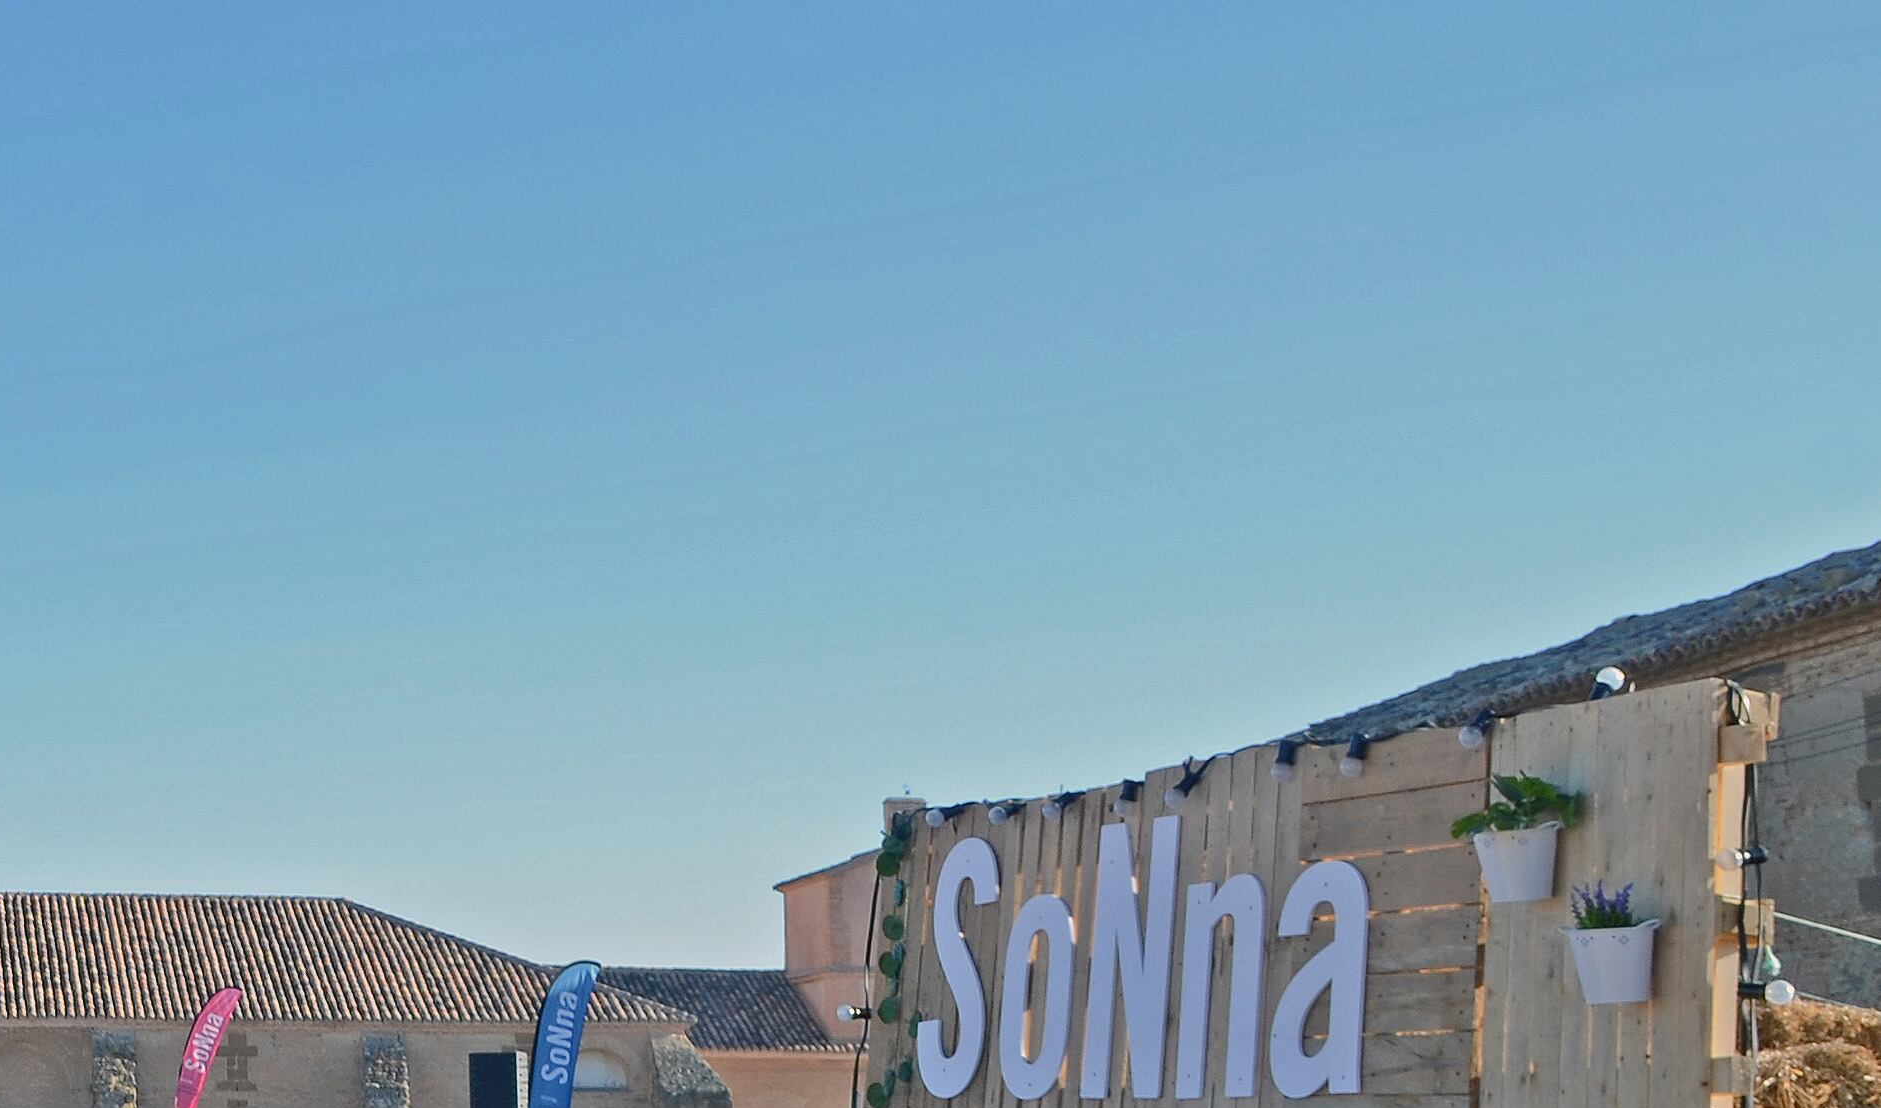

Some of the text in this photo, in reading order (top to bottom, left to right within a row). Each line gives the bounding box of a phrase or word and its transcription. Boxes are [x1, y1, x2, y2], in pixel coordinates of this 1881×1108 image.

[917, 815, 1370, 1100] SoNna
[184, 1012, 225, 1074] SoNna
[541, 991, 578, 1085] SoNna
